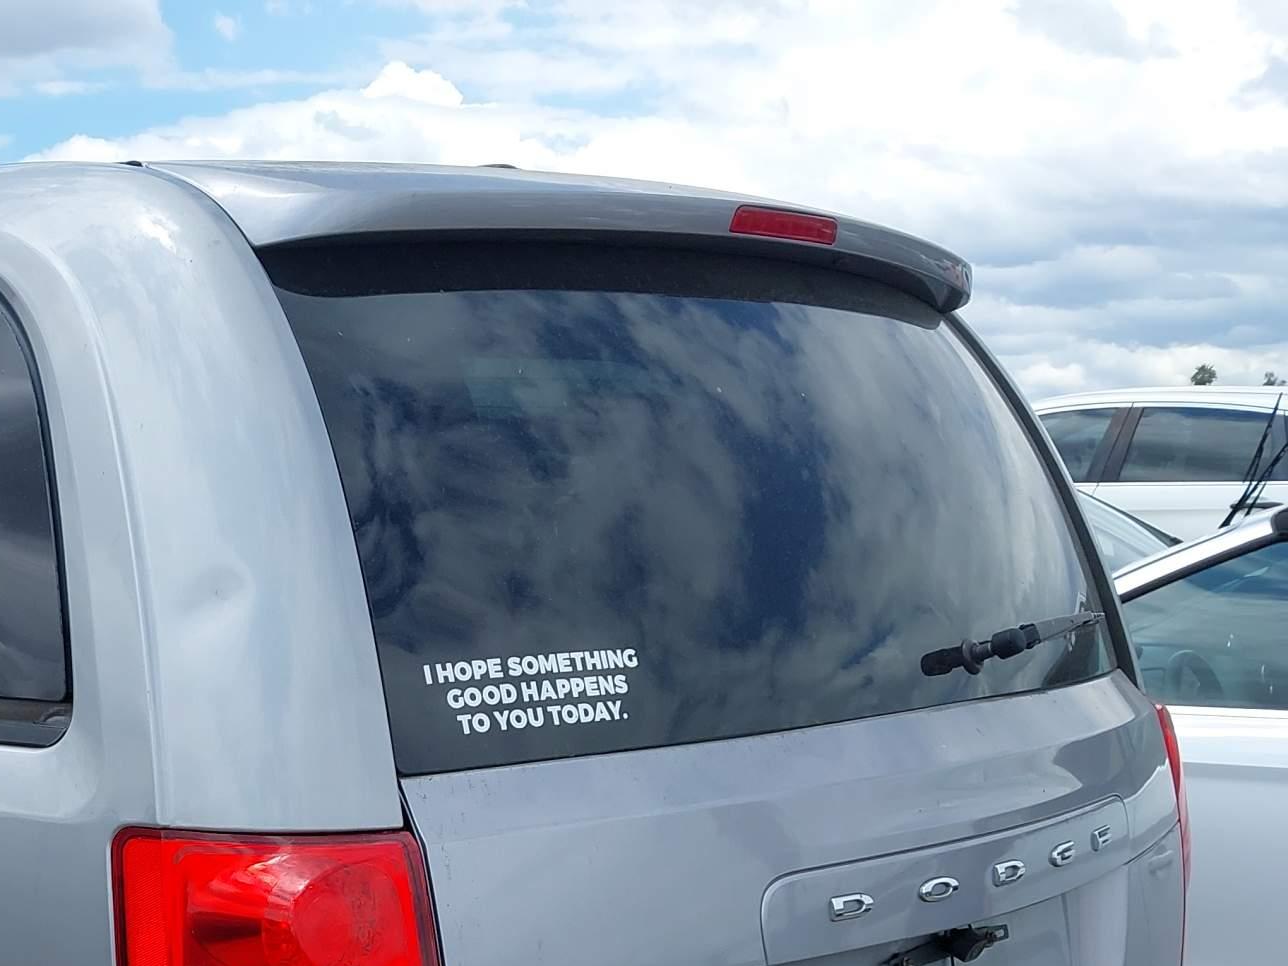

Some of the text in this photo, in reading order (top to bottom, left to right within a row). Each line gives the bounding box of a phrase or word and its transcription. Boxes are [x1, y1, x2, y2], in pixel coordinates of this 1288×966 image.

[423, 648, 639, 685] I HOPE SOMETHING
[446, 674, 629, 709] GOOD HAPPENS
[456, 700, 629, 735] TO YOU TODAY.
[829, 824, 1112, 922] DODGE
